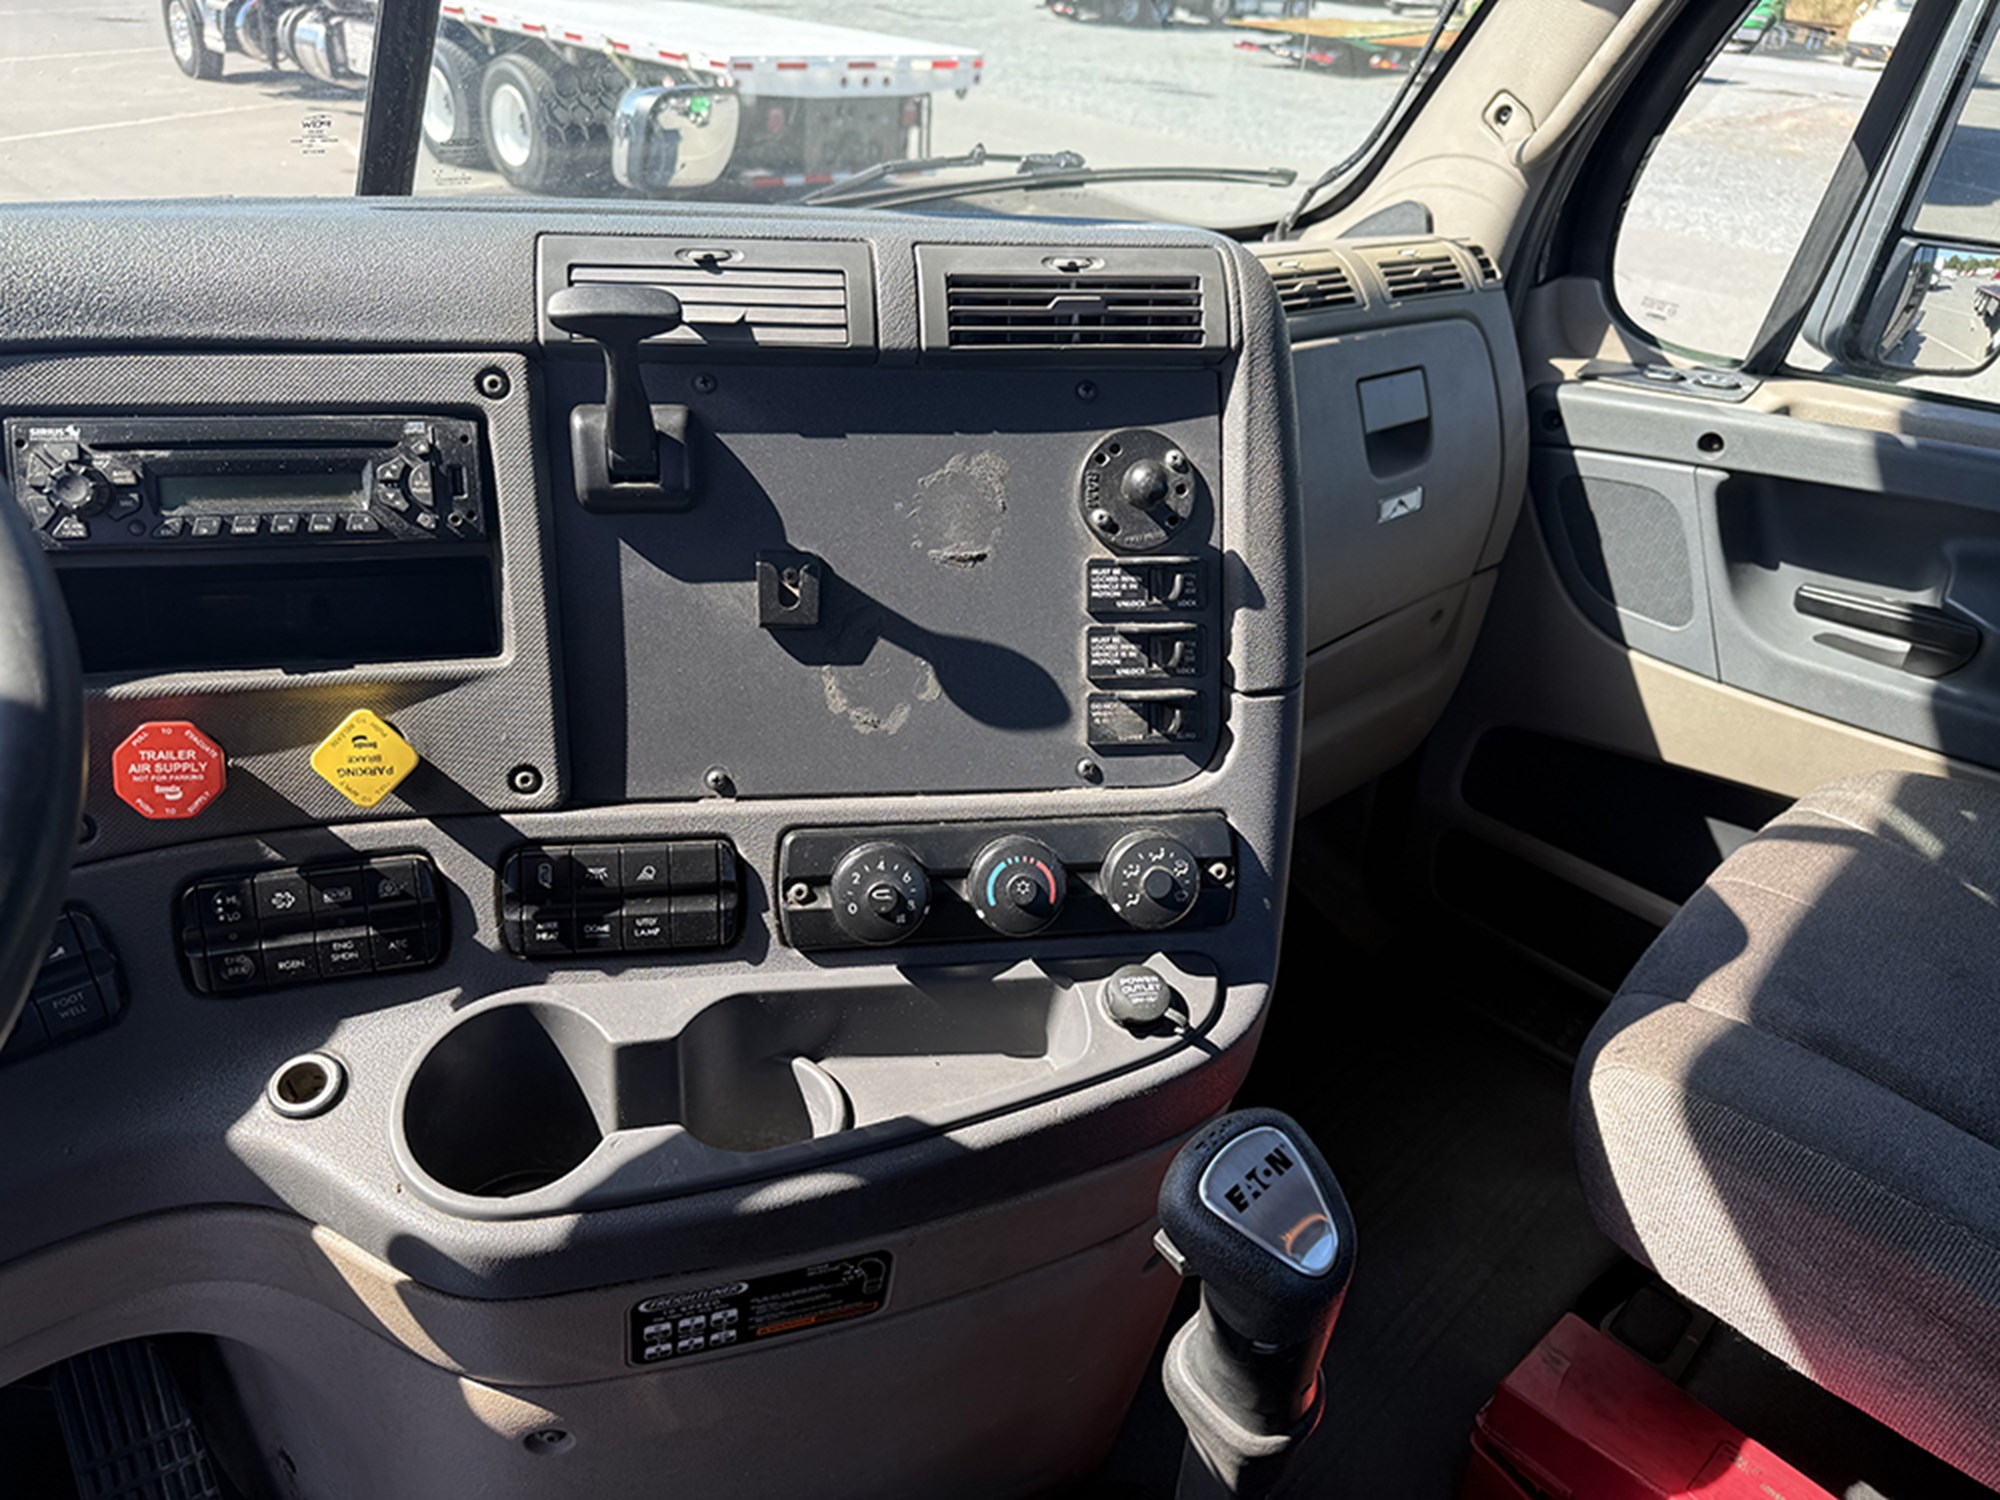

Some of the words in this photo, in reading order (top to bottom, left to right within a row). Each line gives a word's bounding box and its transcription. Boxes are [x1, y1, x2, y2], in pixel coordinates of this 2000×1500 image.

[1085, 469, 1101, 510] RAM
[131, 732, 149, 746] PULL
[185, 729, 218, 759] EVACUATE
[139, 750, 197, 761] TRAILER
[348, 754, 382, 763] BRAKE
[128, 763, 152, 774] AIR
[154, 761, 209, 773] SUPPLY
[336, 766, 394, 778] PARKING
[132, 774, 149, 782] NOT
[151, 774, 168, 782] FOR
[169, 773, 205, 781] PARKING
[136, 798, 155, 815] PUSH
[187, 791, 211, 814] SUPPLY
[876, 859, 886, 872] 4
[851, 870, 862, 885] 2
[901, 869, 913, 884] 6
[847, 901, 859, 915] 0
[226, 912, 241, 922] LO
[584, 924, 611, 934] DOME
[634, 927, 661, 937] LAMP
[332, 942, 354, 950] ENG
[277, 959, 306, 971] RGEN
[1120, 976, 1159, 986] POWER
[1121, 984, 1161, 994] OUTLET
[52, 991, 85, 1009] FOOT
[58, 1005, 87, 1019] WELL
[1224, 1147, 1294, 1214] EATON
